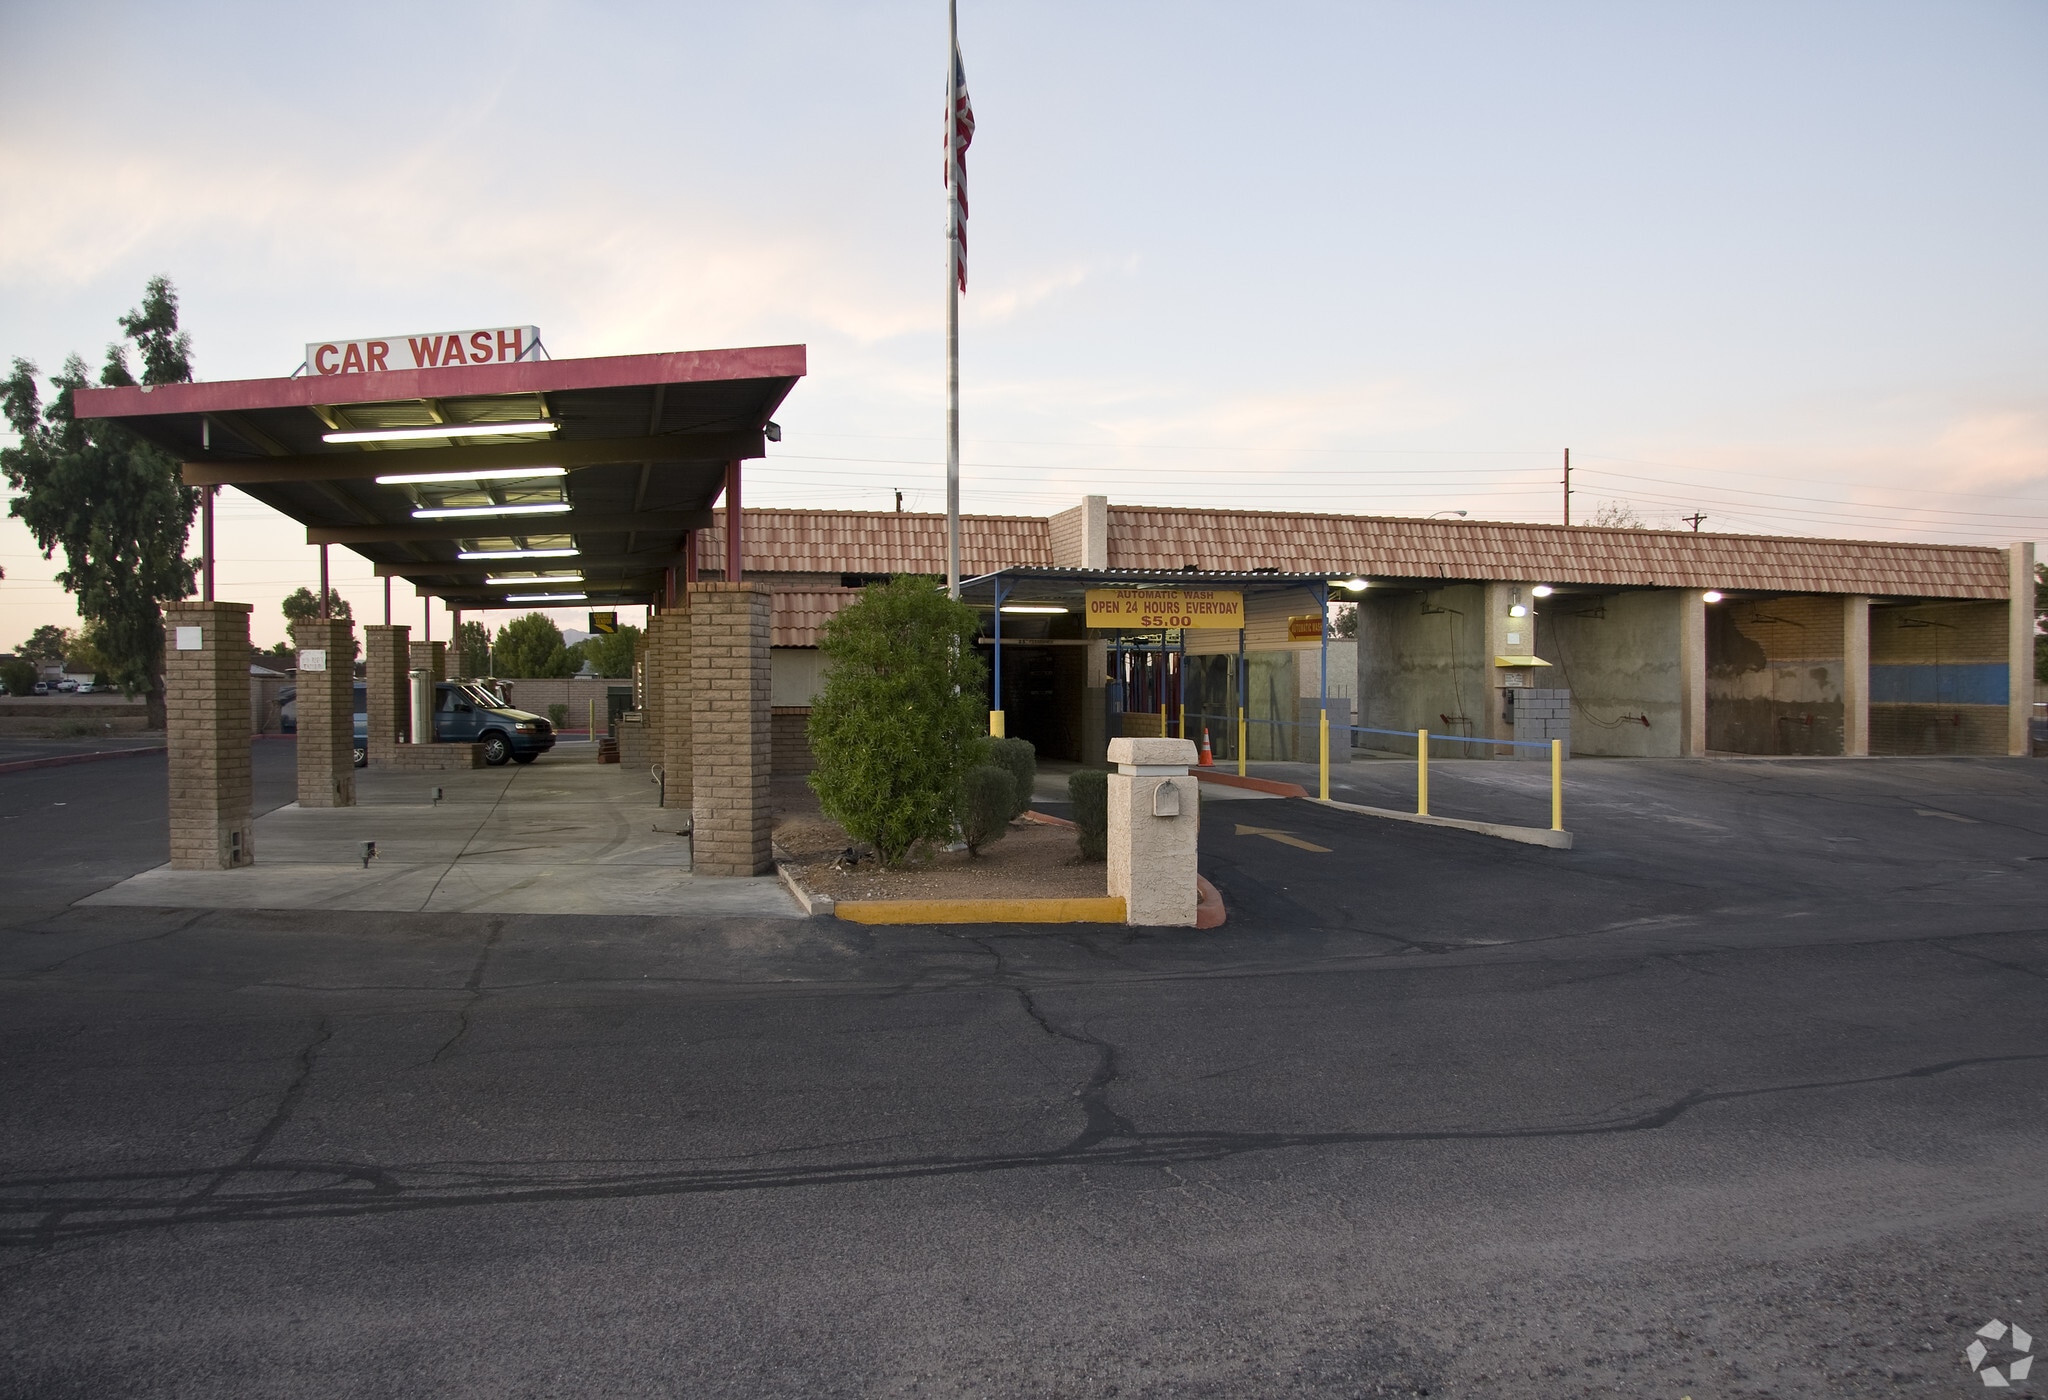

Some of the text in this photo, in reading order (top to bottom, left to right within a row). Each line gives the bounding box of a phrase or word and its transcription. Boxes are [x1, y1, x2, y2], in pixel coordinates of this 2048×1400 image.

[315, 328, 522, 376] CAR WASH
[1116, 590, 1214, 600] AUTOMATIC WASH
[1091, 601, 1238, 615] OPEN 24 HOURS EVERYDAY
[1140, 615, 1192, 627] $5.00
